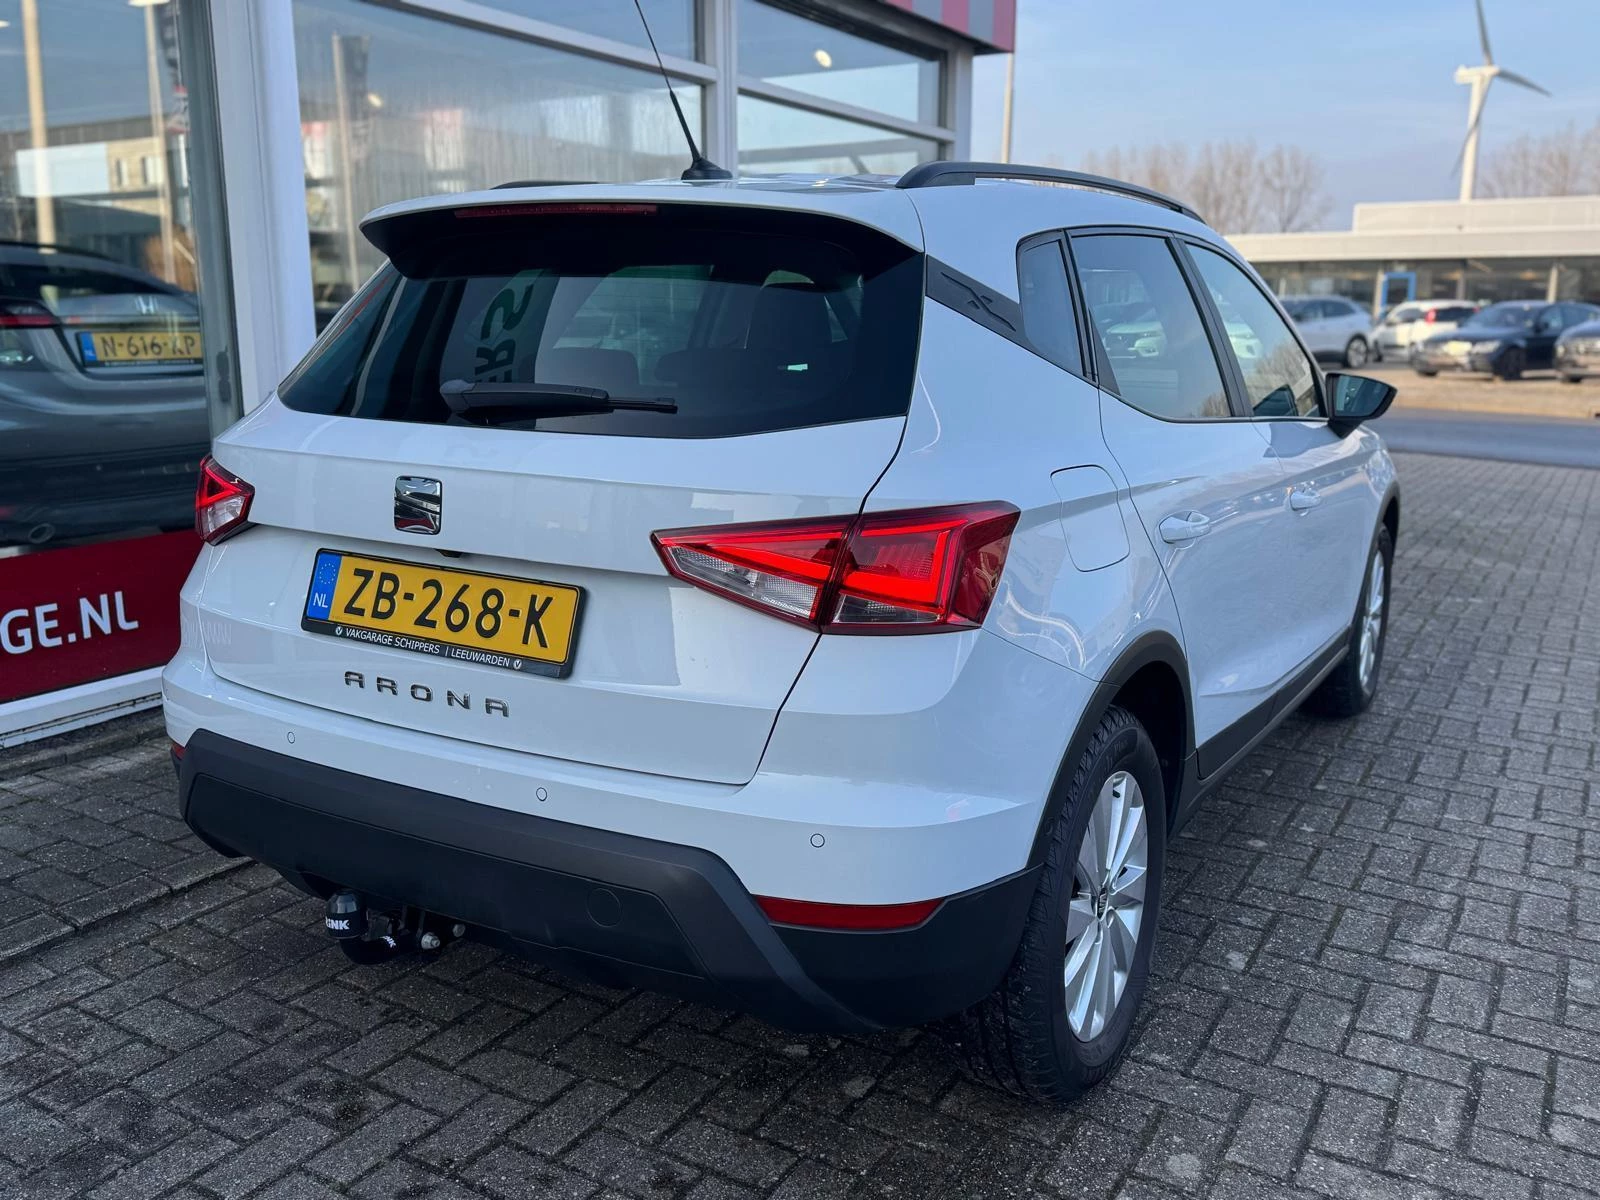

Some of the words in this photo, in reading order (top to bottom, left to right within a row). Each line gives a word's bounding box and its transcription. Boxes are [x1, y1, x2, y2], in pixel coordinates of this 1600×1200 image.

[0, 590, 139, 655] GE.NL
[312, 592, 329, 609] NL
[343, 567, 554, 649] ZB-268-K
[345, 627, 394, 646] VAKGARAGE
[394, 637, 440, 655] SCHIPPERS
[451, 647, 511, 667] LEEUWARDEN
[344, 670, 510, 718] ARONA
